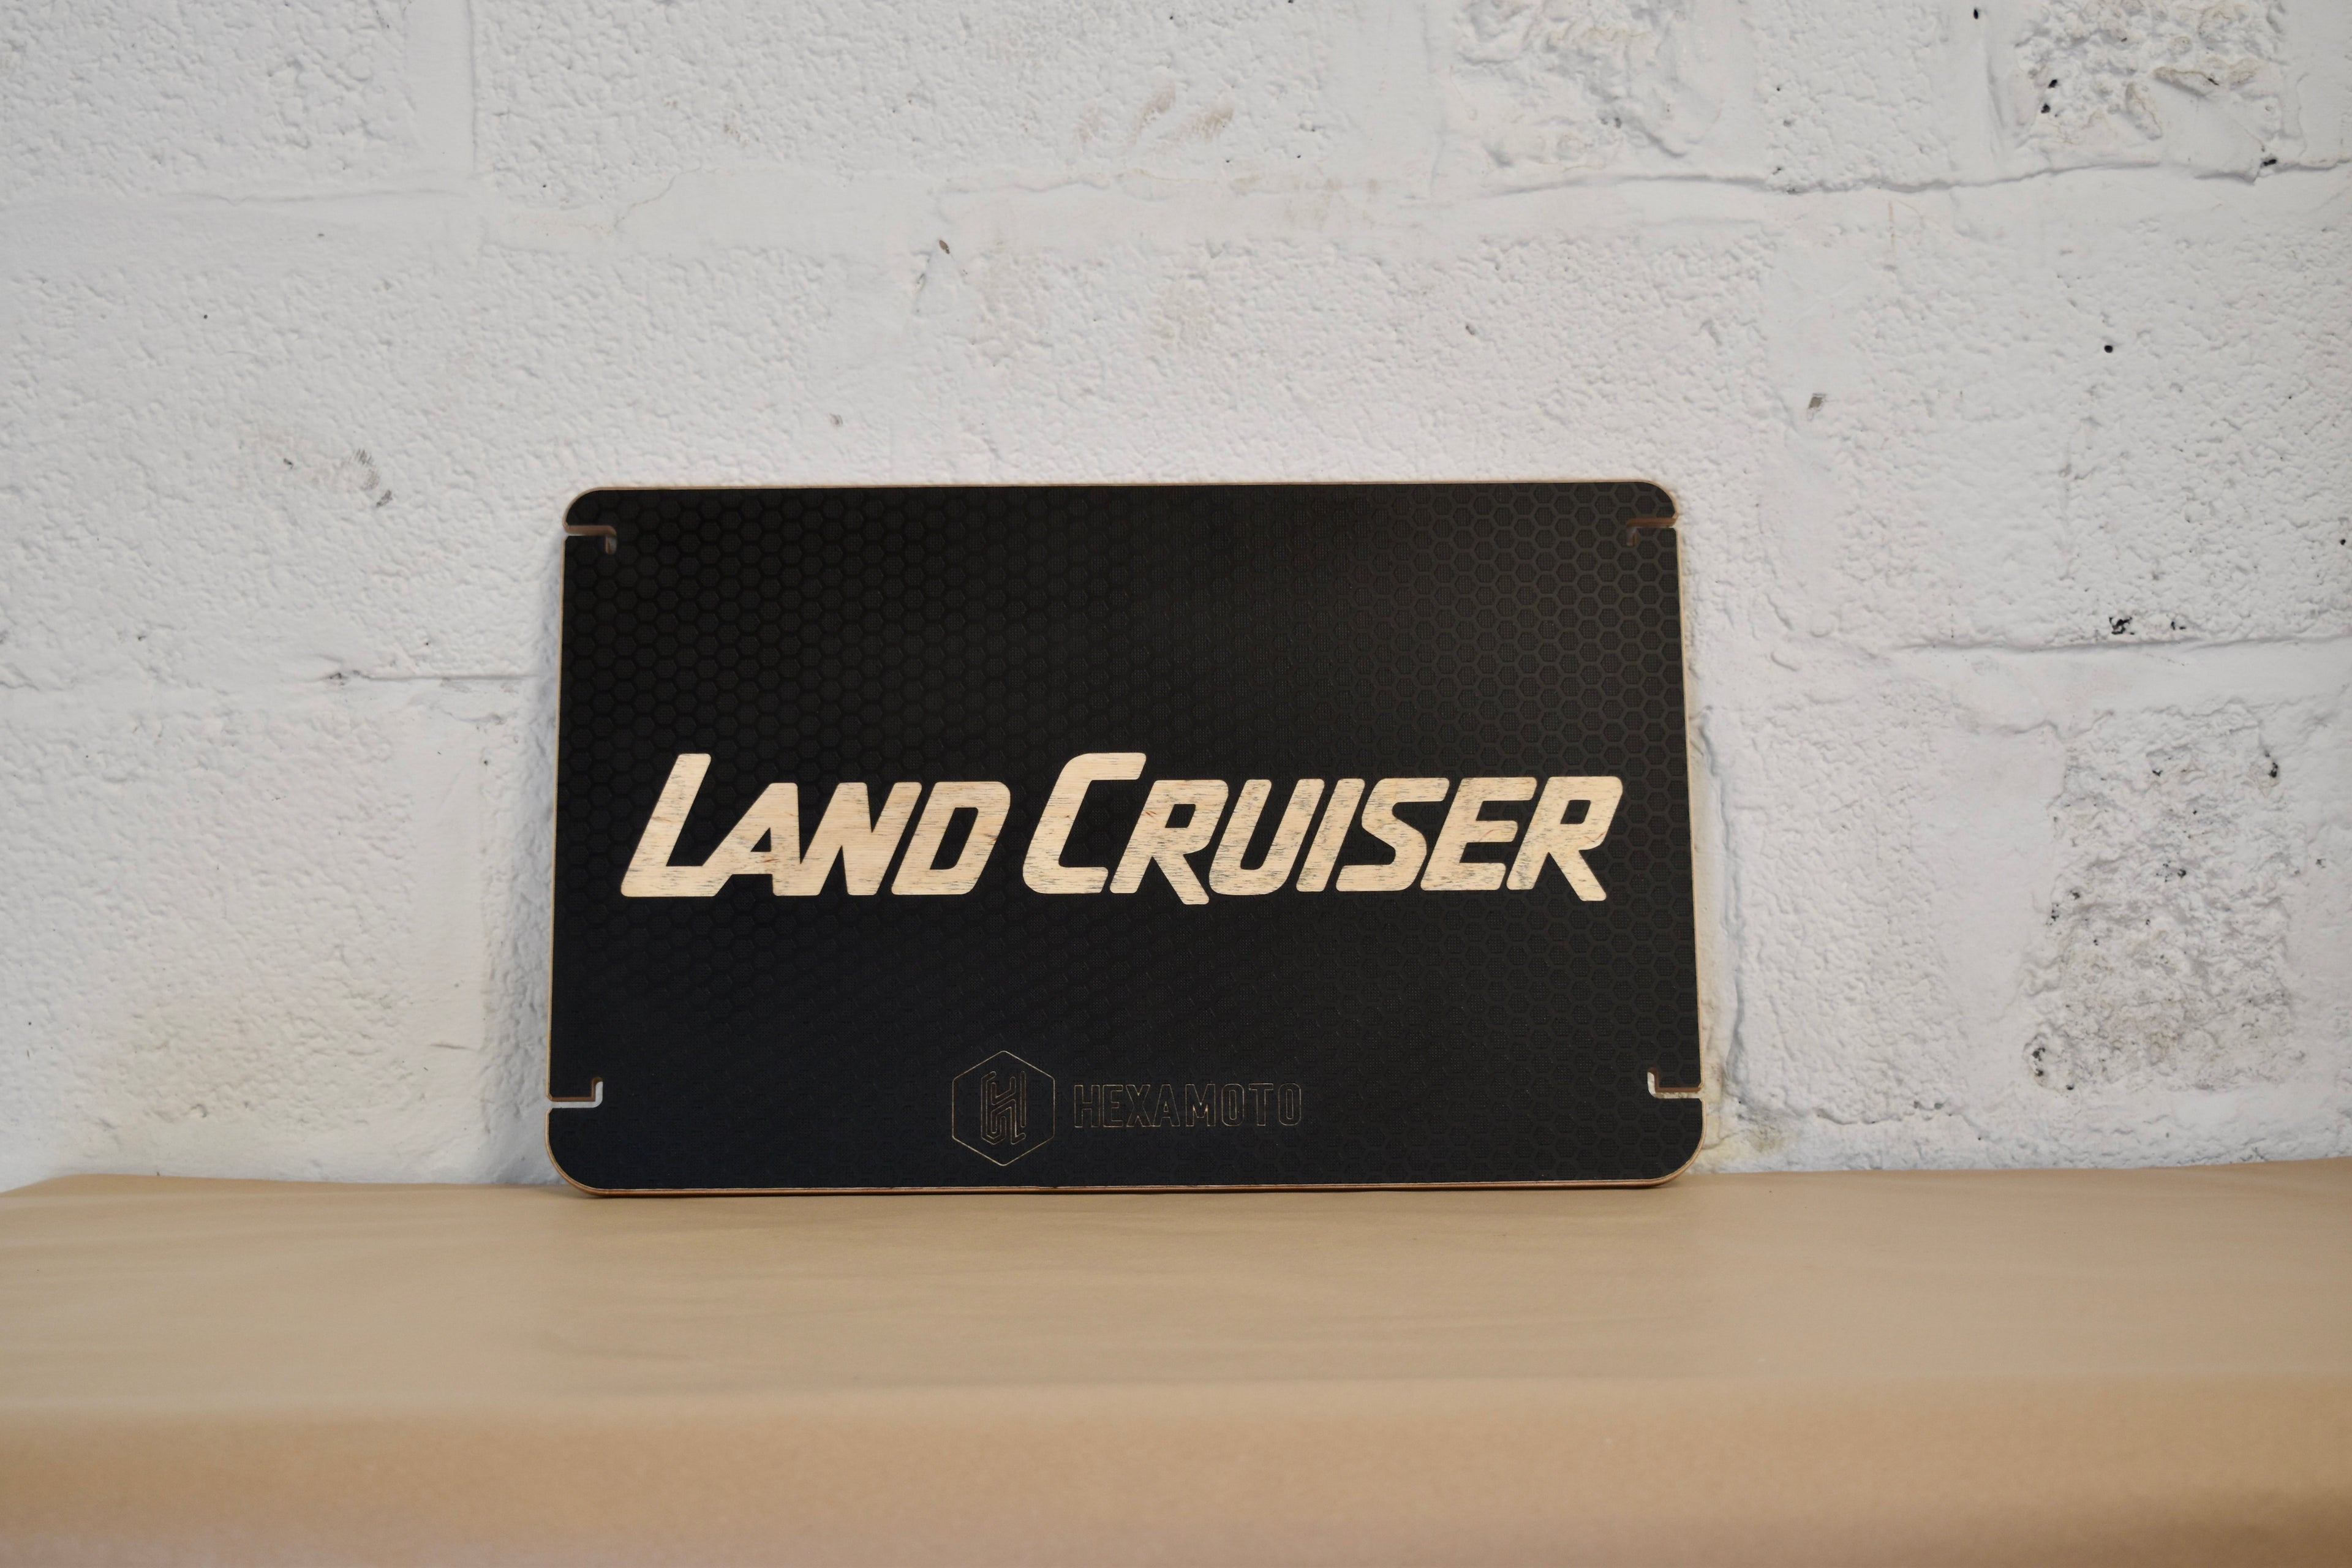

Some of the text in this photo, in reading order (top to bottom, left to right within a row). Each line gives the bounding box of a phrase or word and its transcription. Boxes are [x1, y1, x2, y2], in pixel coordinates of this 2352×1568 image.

[620, 752, 1624, 905] LAND CRUISER
[1073, 1082, 1302, 1128] HEXAMOTO
